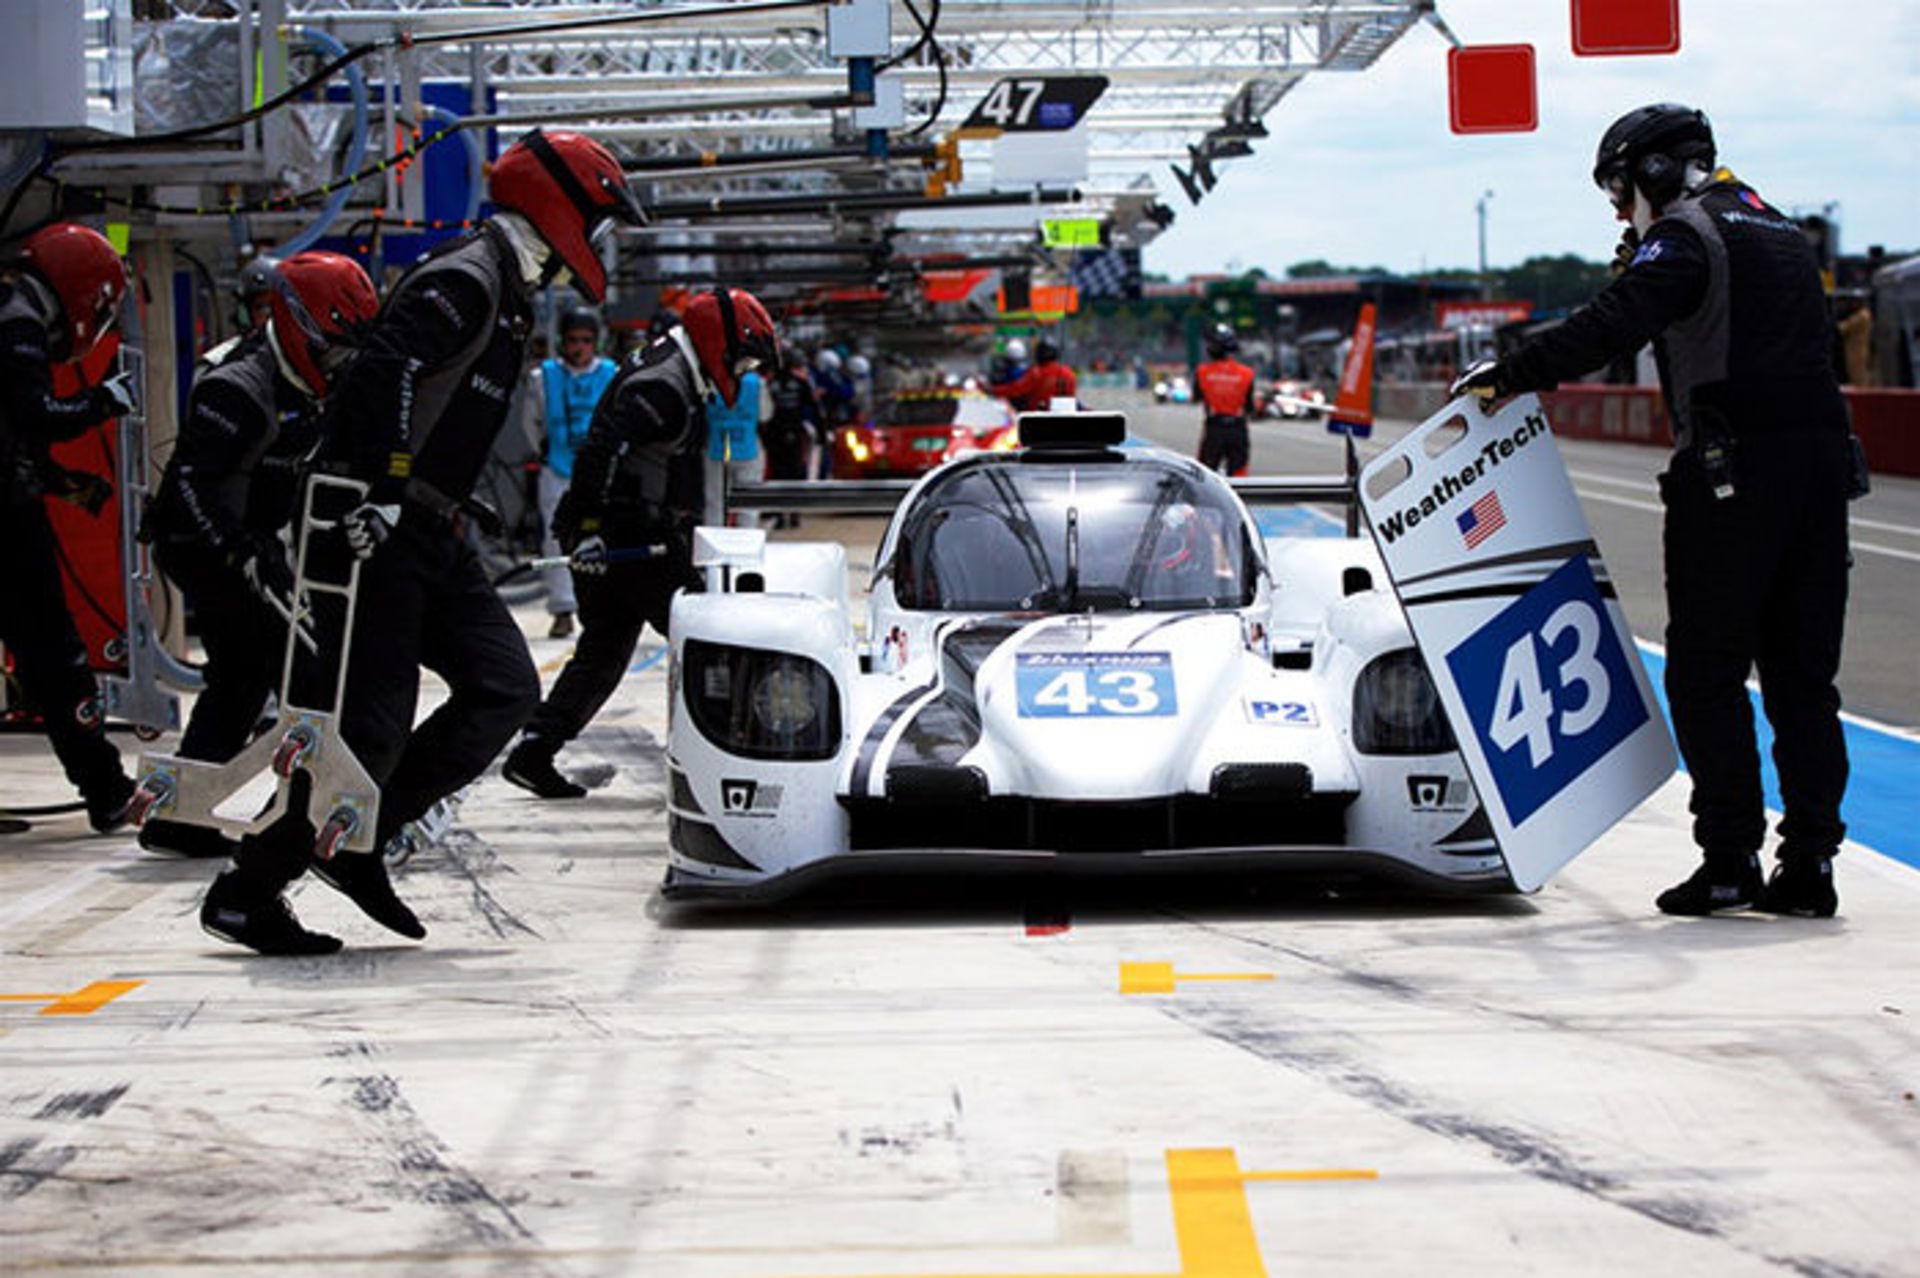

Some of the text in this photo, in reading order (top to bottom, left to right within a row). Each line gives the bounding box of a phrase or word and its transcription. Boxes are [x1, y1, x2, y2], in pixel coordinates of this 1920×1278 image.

[981, 81, 1044, 125] 47
[1378, 413, 1546, 543] WeatherTech
[1034, 671, 1160, 714] 43
[1489, 600, 1611, 769] 43
[1251, 701, 1310, 722] P2
